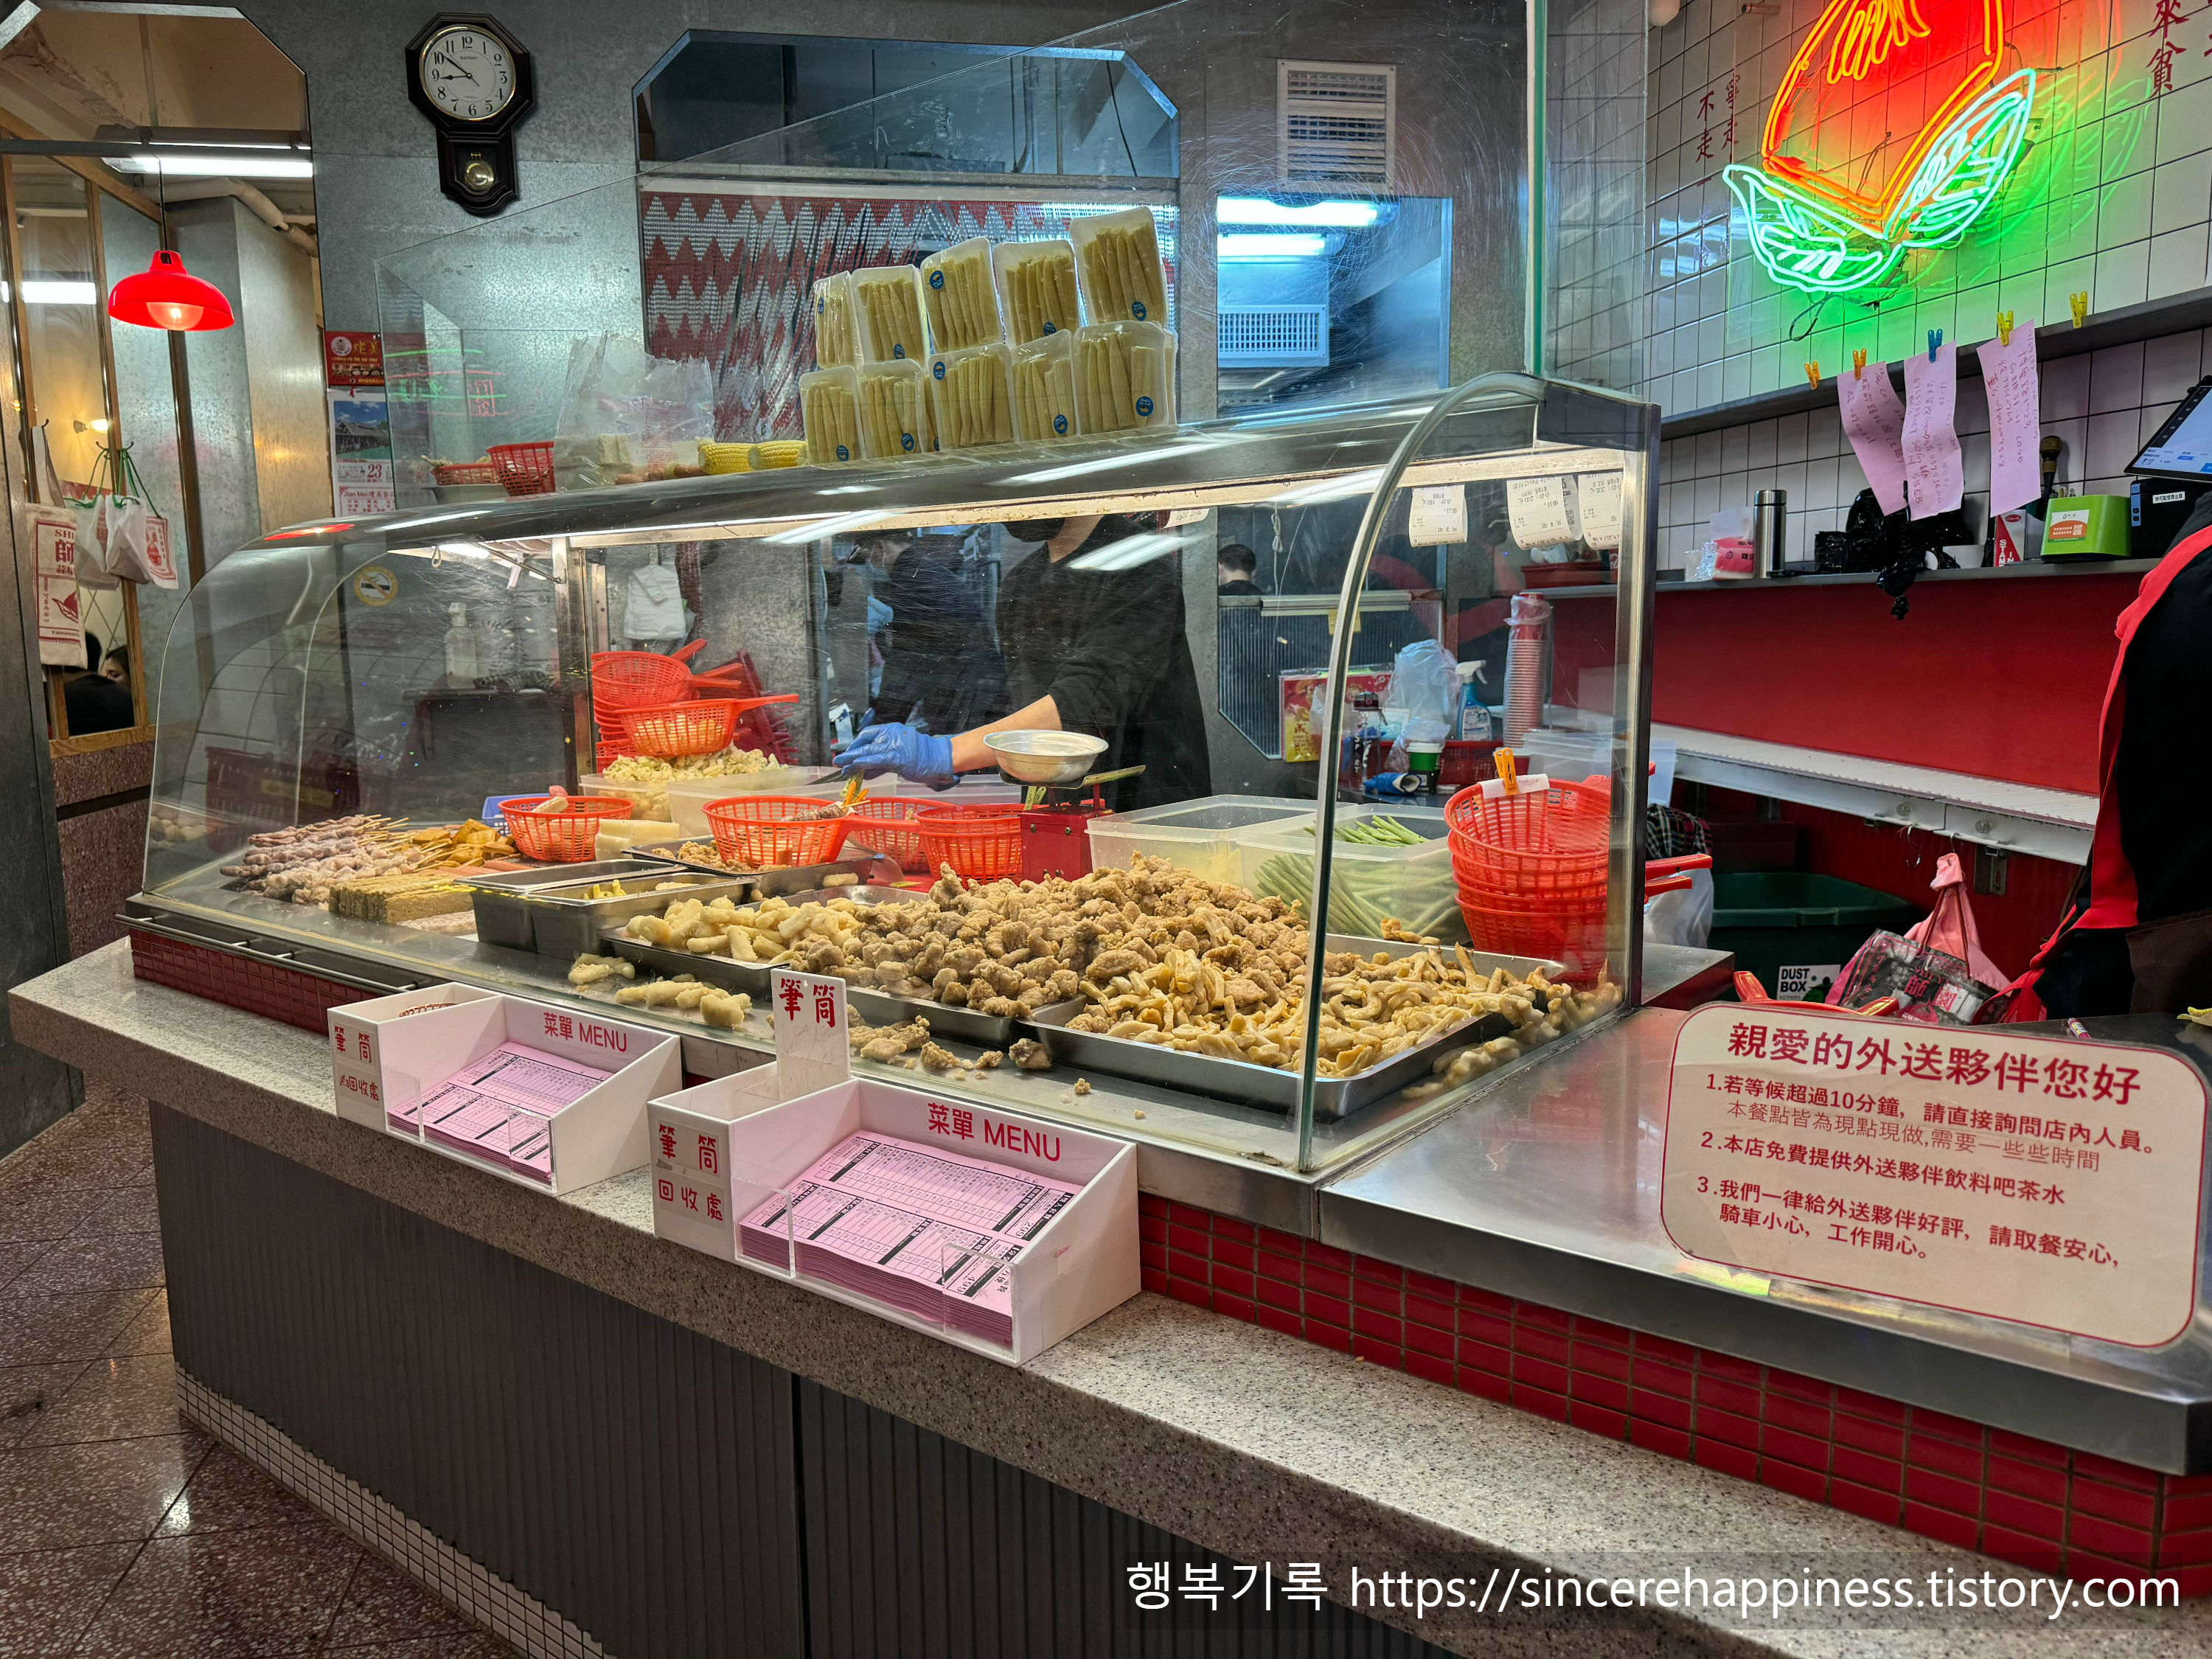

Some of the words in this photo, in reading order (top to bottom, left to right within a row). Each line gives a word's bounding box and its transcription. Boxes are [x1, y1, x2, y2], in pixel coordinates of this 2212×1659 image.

[446, 40, 454, 53] 11
[462, 36, 473, 49] 12
[482, 41, 487, 54] 1
[493, 54, 502, 66] 2
[431, 69, 440, 81] 9
[499, 72, 507, 84] 3
[437, 86, 446, 100] 8
[495, 88, 504, 101] 4
[451, 99, 459, 111] 7
[468, 104, 477, 116] 6
[485, 100, 493, 112] 5
[367, 464, 383, 479] 23
[1781, 968, 1810, 980] DUST
[1780, 981, 1807, 992] BOX
[543, 1012, 574, 1041] 菜單
[579, 1022, 628, 1053] MENU
[1728, 1021, 2141, 1106] 親愛的外送夥伴您好
[928, 1102, 975, 1141] 菜單
[984, 1119, 1062, 1162] MENU
[1014, 1221, 1034, 1237] 299
[956, 1275, 977, 1293] 499
